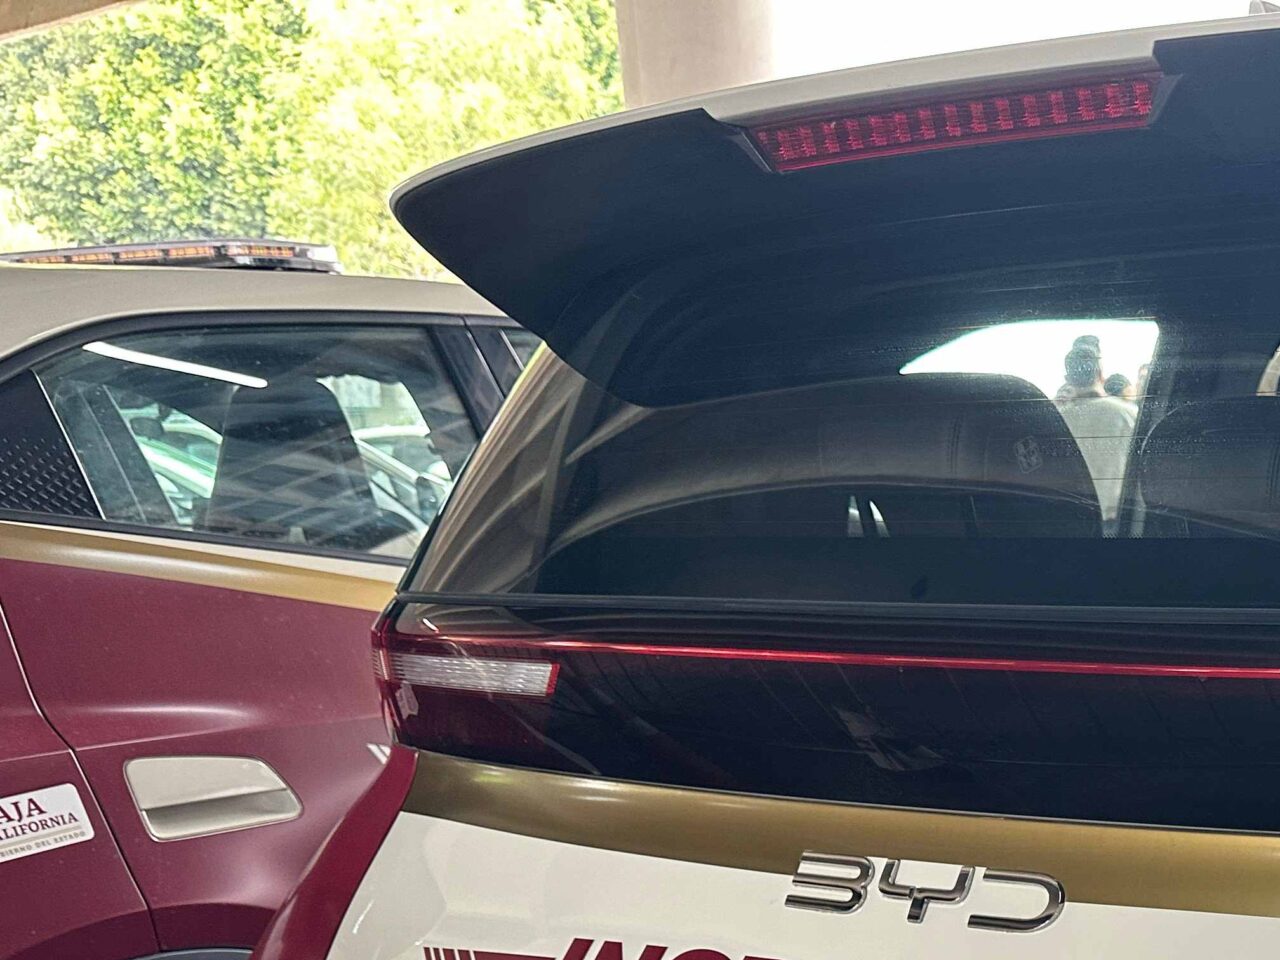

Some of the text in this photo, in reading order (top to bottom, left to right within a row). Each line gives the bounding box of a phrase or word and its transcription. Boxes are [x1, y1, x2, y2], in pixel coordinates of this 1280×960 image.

[0, 798, 47, 823] AJA
[0, 812, 79, 841] LIFORNIA
[784, 851, 1066, 933] BYD
